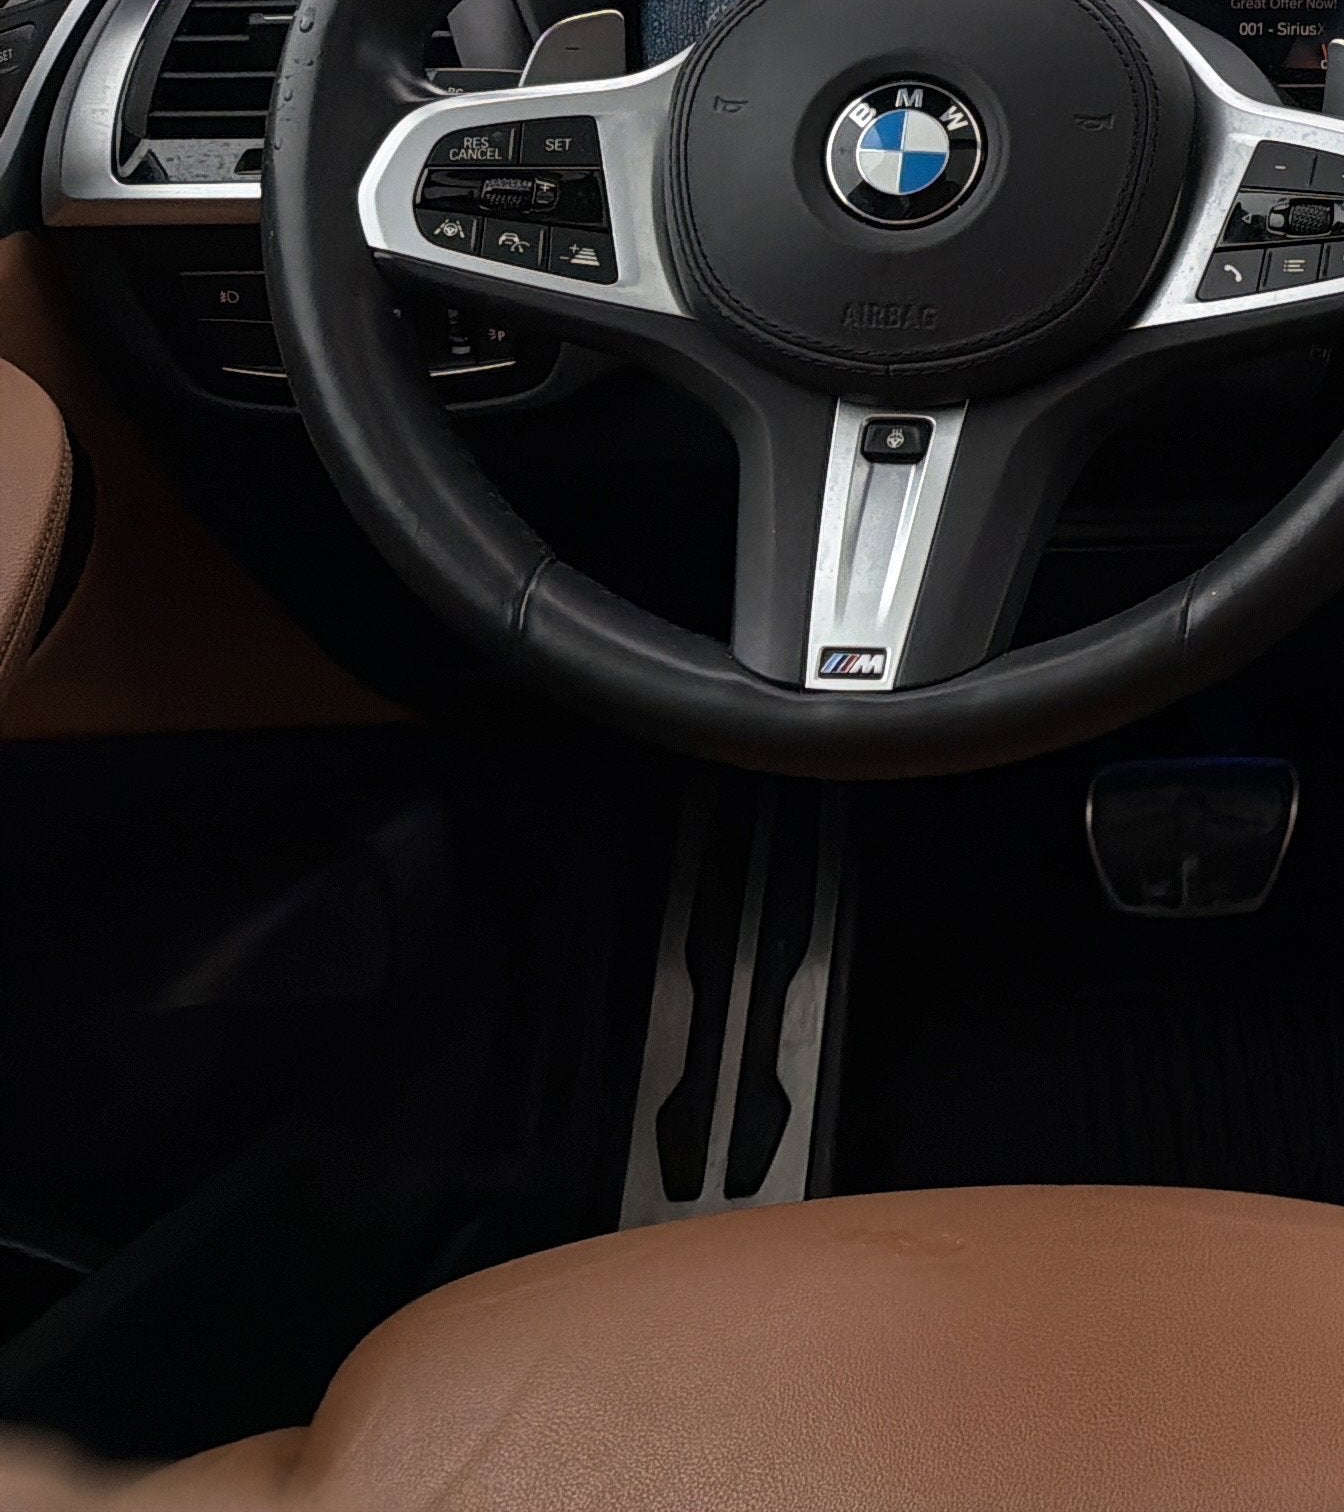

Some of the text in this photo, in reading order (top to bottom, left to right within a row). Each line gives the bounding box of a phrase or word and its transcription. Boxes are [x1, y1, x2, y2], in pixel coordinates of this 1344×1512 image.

[1239, 22, 1263, 36] 001
[849, 87, 969, 132] BMW
[463, 137, 489, 149] RES
[545, 138, 572, 152] SET
[449, 149, 503, 161] CANCEL
[842, 303, 939, 330] AIRBAG
